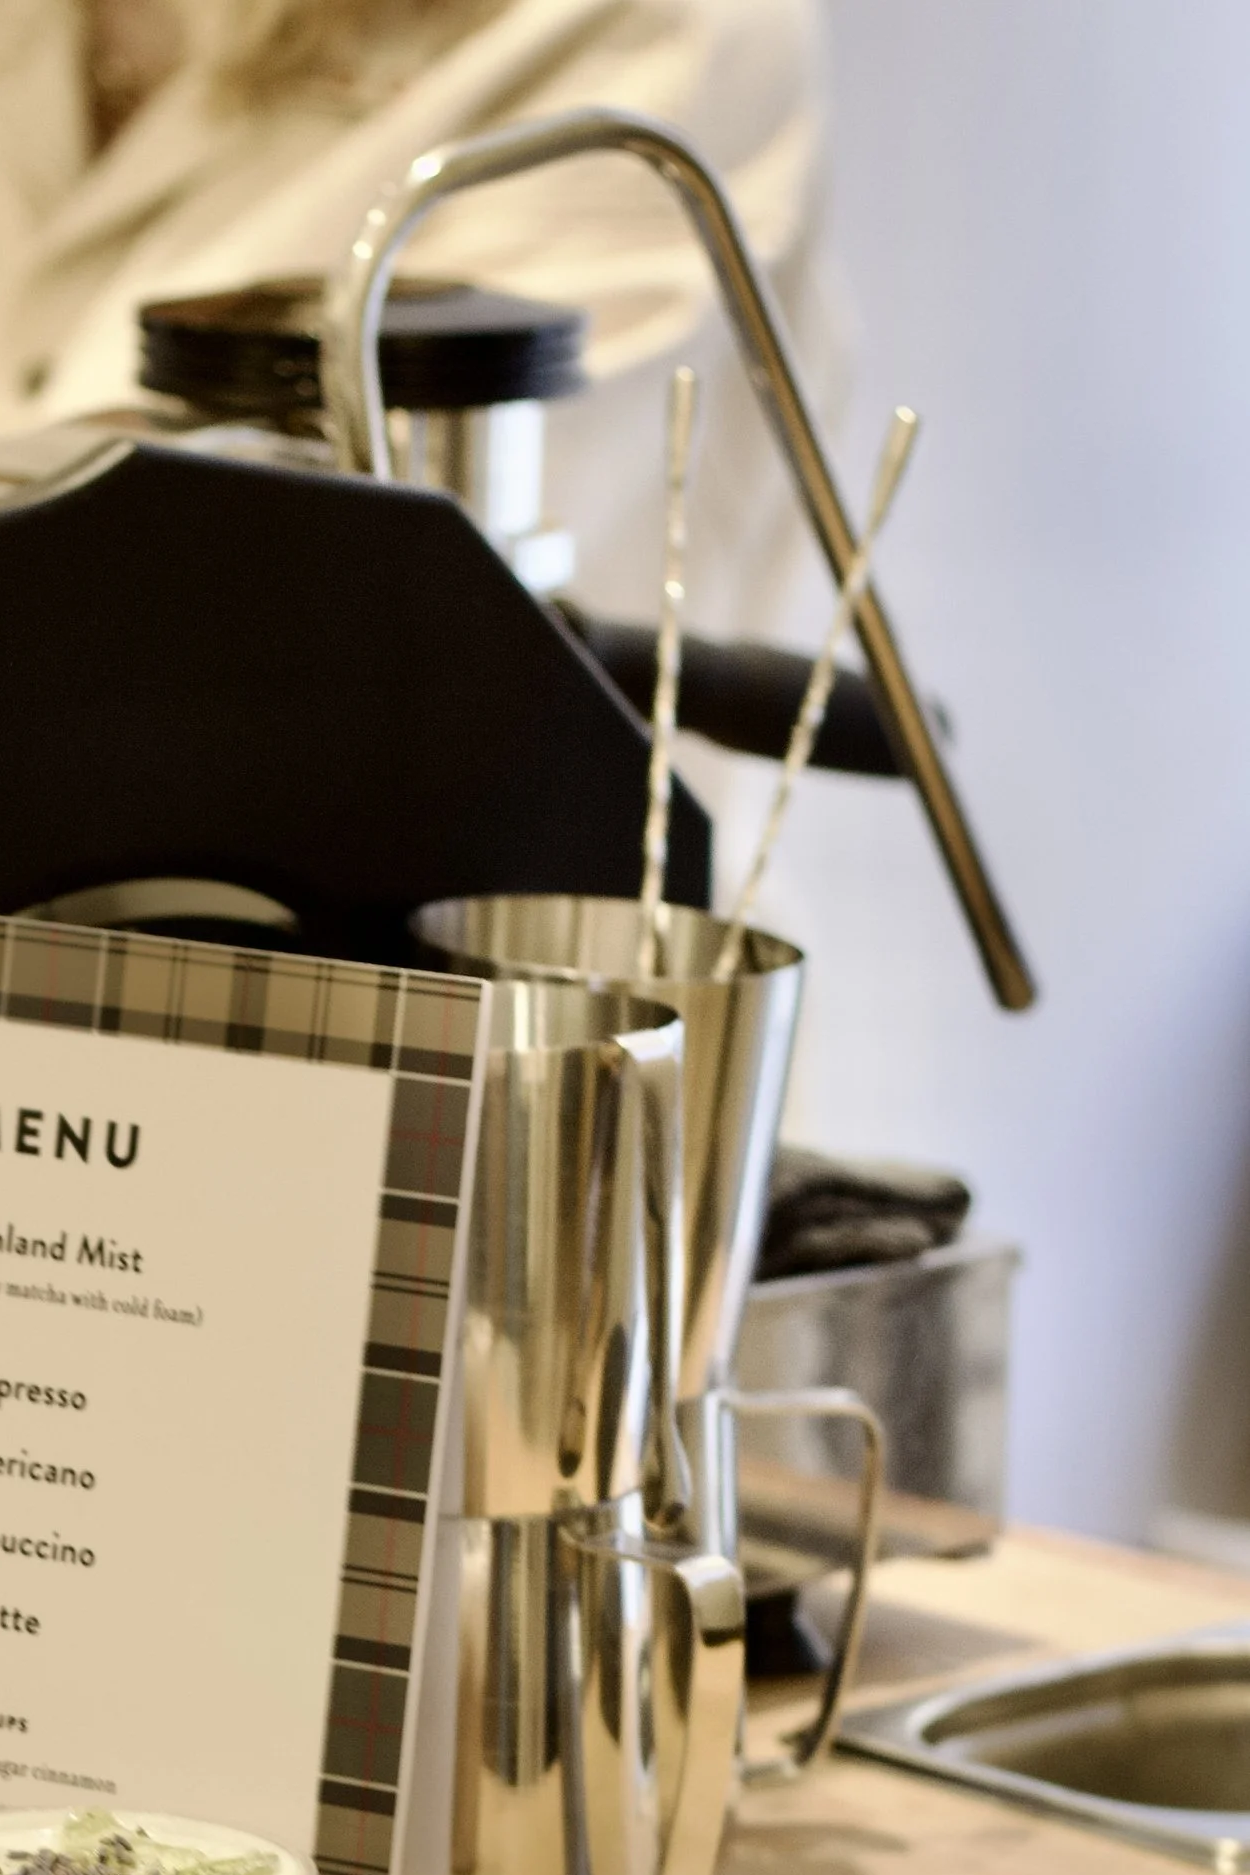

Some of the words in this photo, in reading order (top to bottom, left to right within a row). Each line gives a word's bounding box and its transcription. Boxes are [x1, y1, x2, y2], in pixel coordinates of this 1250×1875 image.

[77, 1233, 144, 1273] Mist
[6, 1280, 66, 1305] matcha
[71, 1289, 108, 1311] with
[111, 1294, 148, 1319] cold
[153, 1298, 204, 1327] foam)
[31, 1764, 116, 1794] cinnamon
